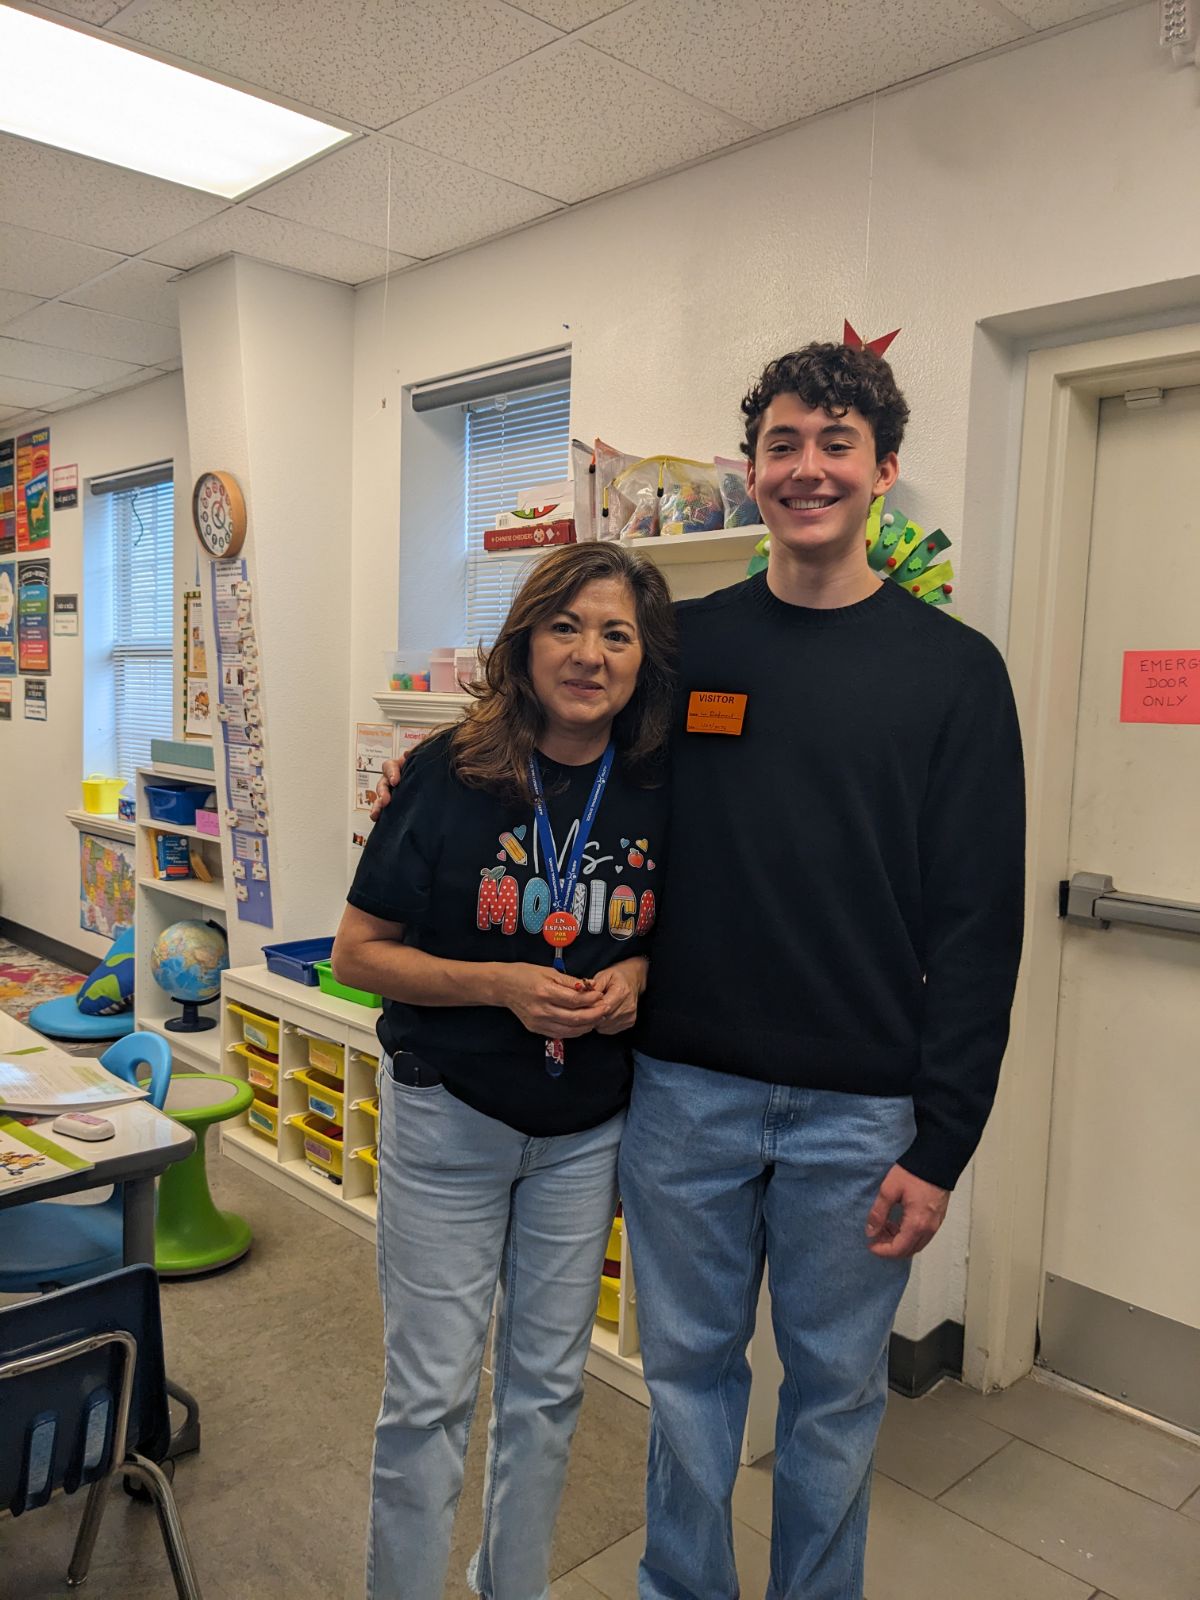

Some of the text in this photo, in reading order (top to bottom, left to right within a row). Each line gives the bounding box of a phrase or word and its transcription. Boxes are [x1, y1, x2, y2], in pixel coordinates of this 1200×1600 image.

[1140, 658, 1200, 672] EMERG
[1145, 677, 1188, 689] DOOR
[699, 694, 735, 704] VISITOR
[1142, 695, 1188, 707] ONLY
